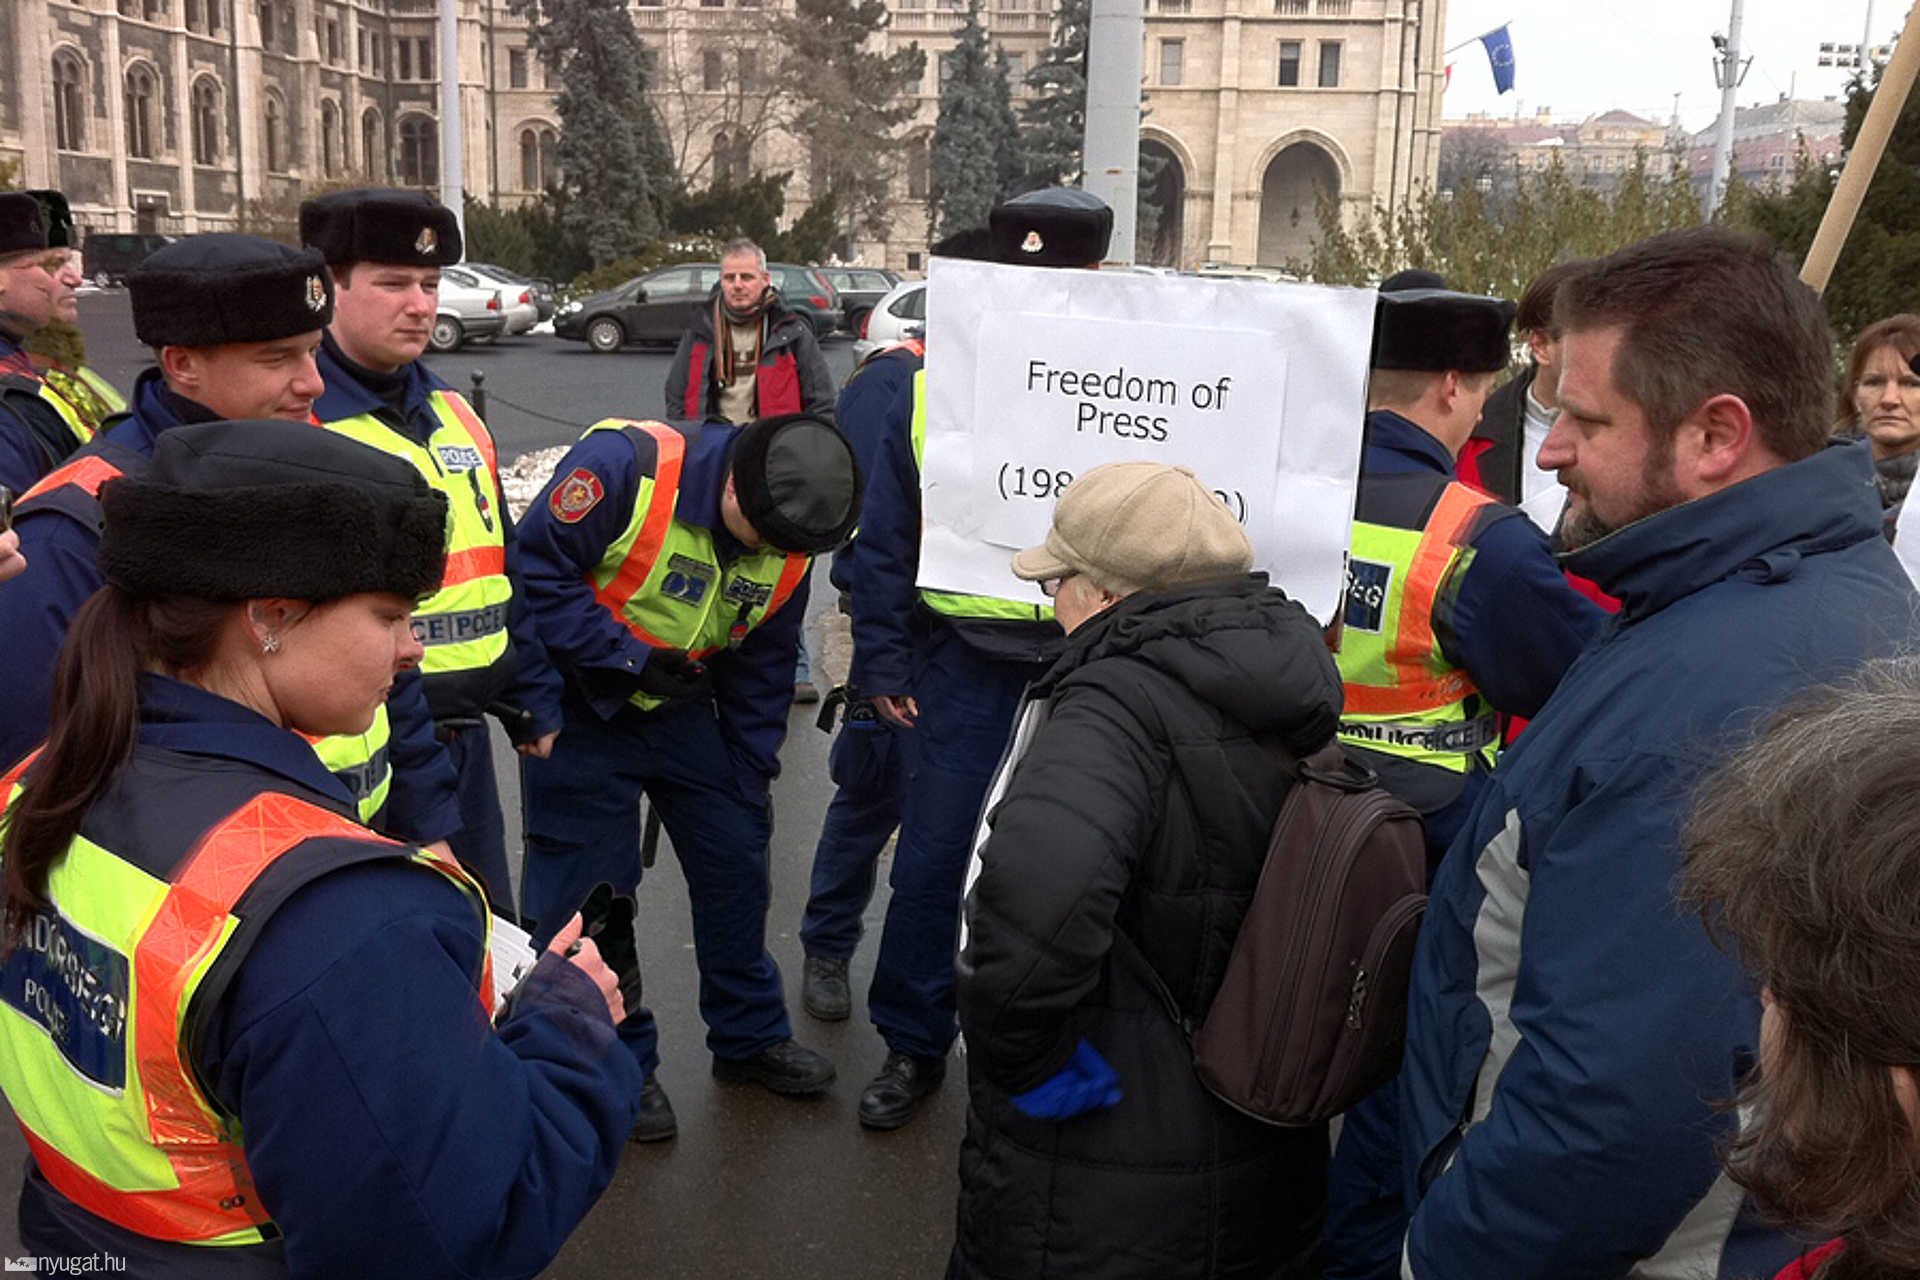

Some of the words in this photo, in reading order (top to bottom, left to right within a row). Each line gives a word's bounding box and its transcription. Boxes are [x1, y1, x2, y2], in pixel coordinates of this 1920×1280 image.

[1027, 360, 1177, 406] Freedom
[1191, 376, 1232, 410] of
[1076, 402, 1169, 442] Press
